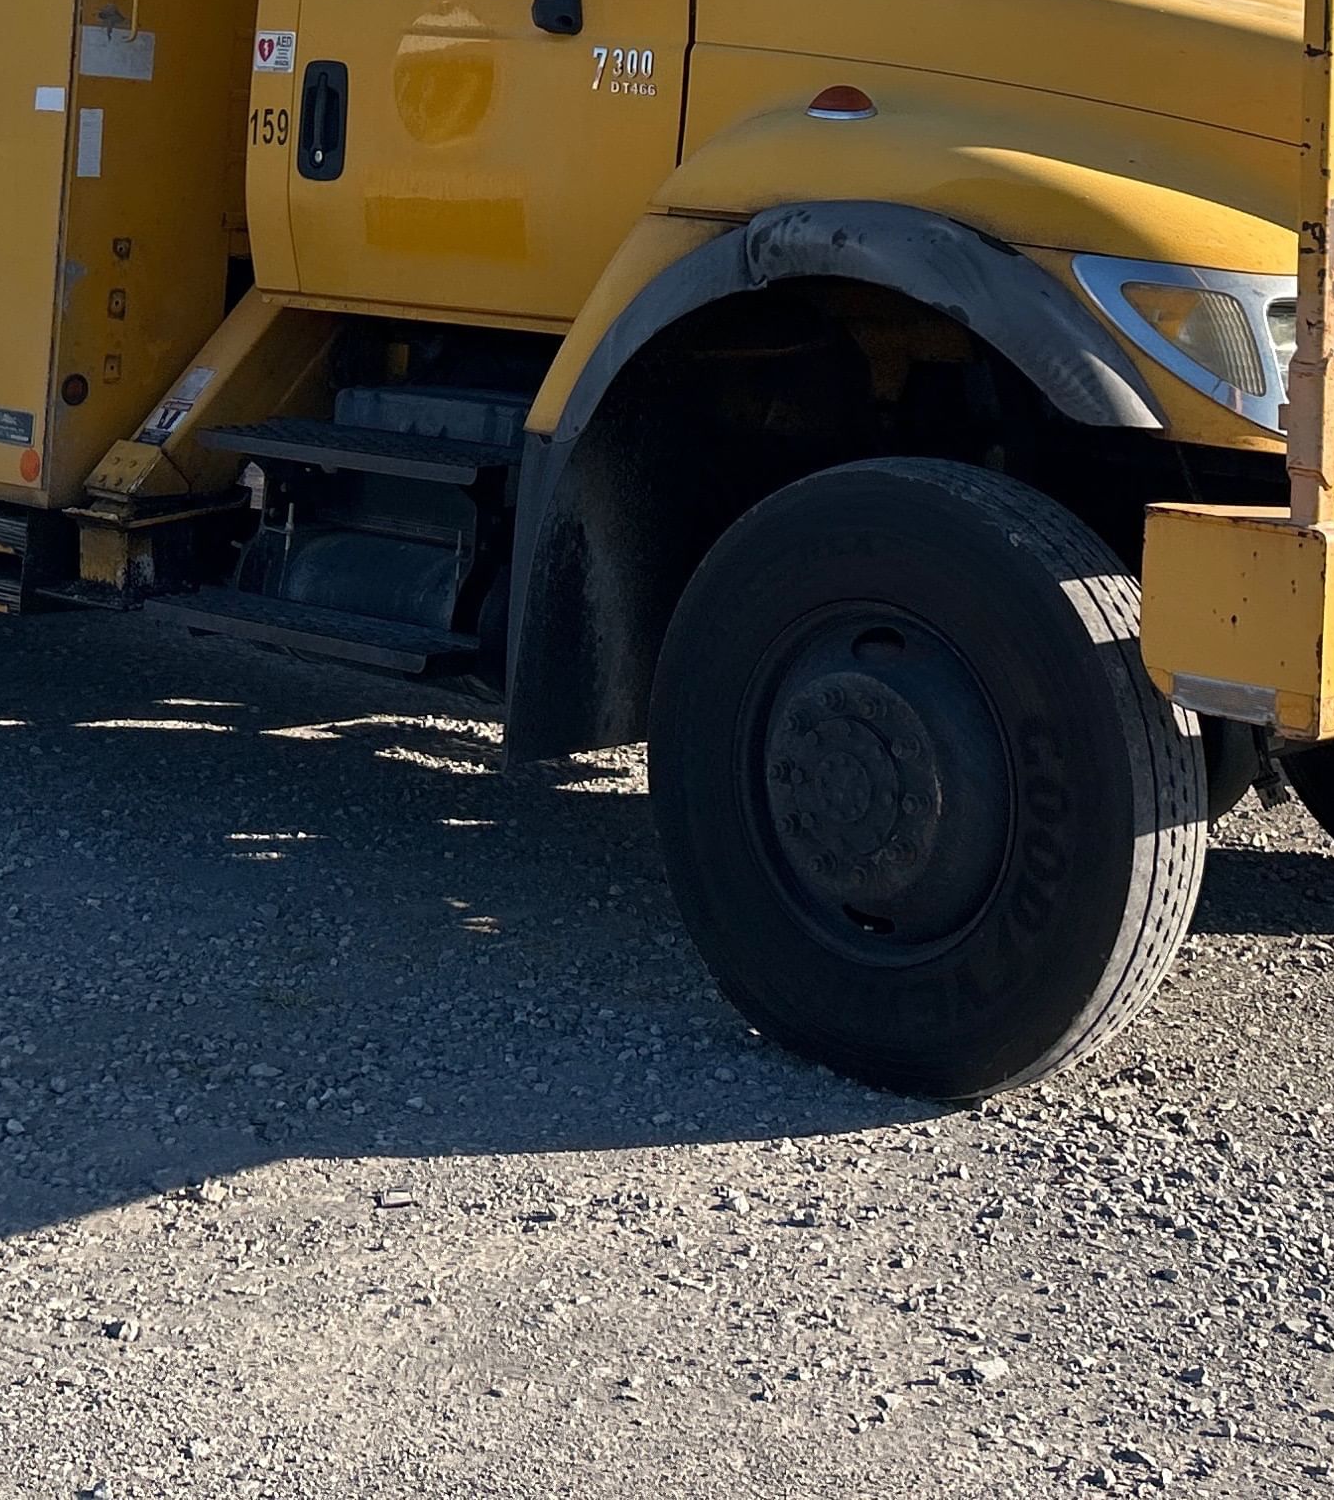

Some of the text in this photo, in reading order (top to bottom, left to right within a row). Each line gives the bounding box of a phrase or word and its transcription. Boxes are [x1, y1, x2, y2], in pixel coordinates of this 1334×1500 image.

[276, 35, 292, 47] AED
[591, 46, 655, 91] 7300
[610, 81, 657, 97] DT466
[250, 108, 289, 147] 159
